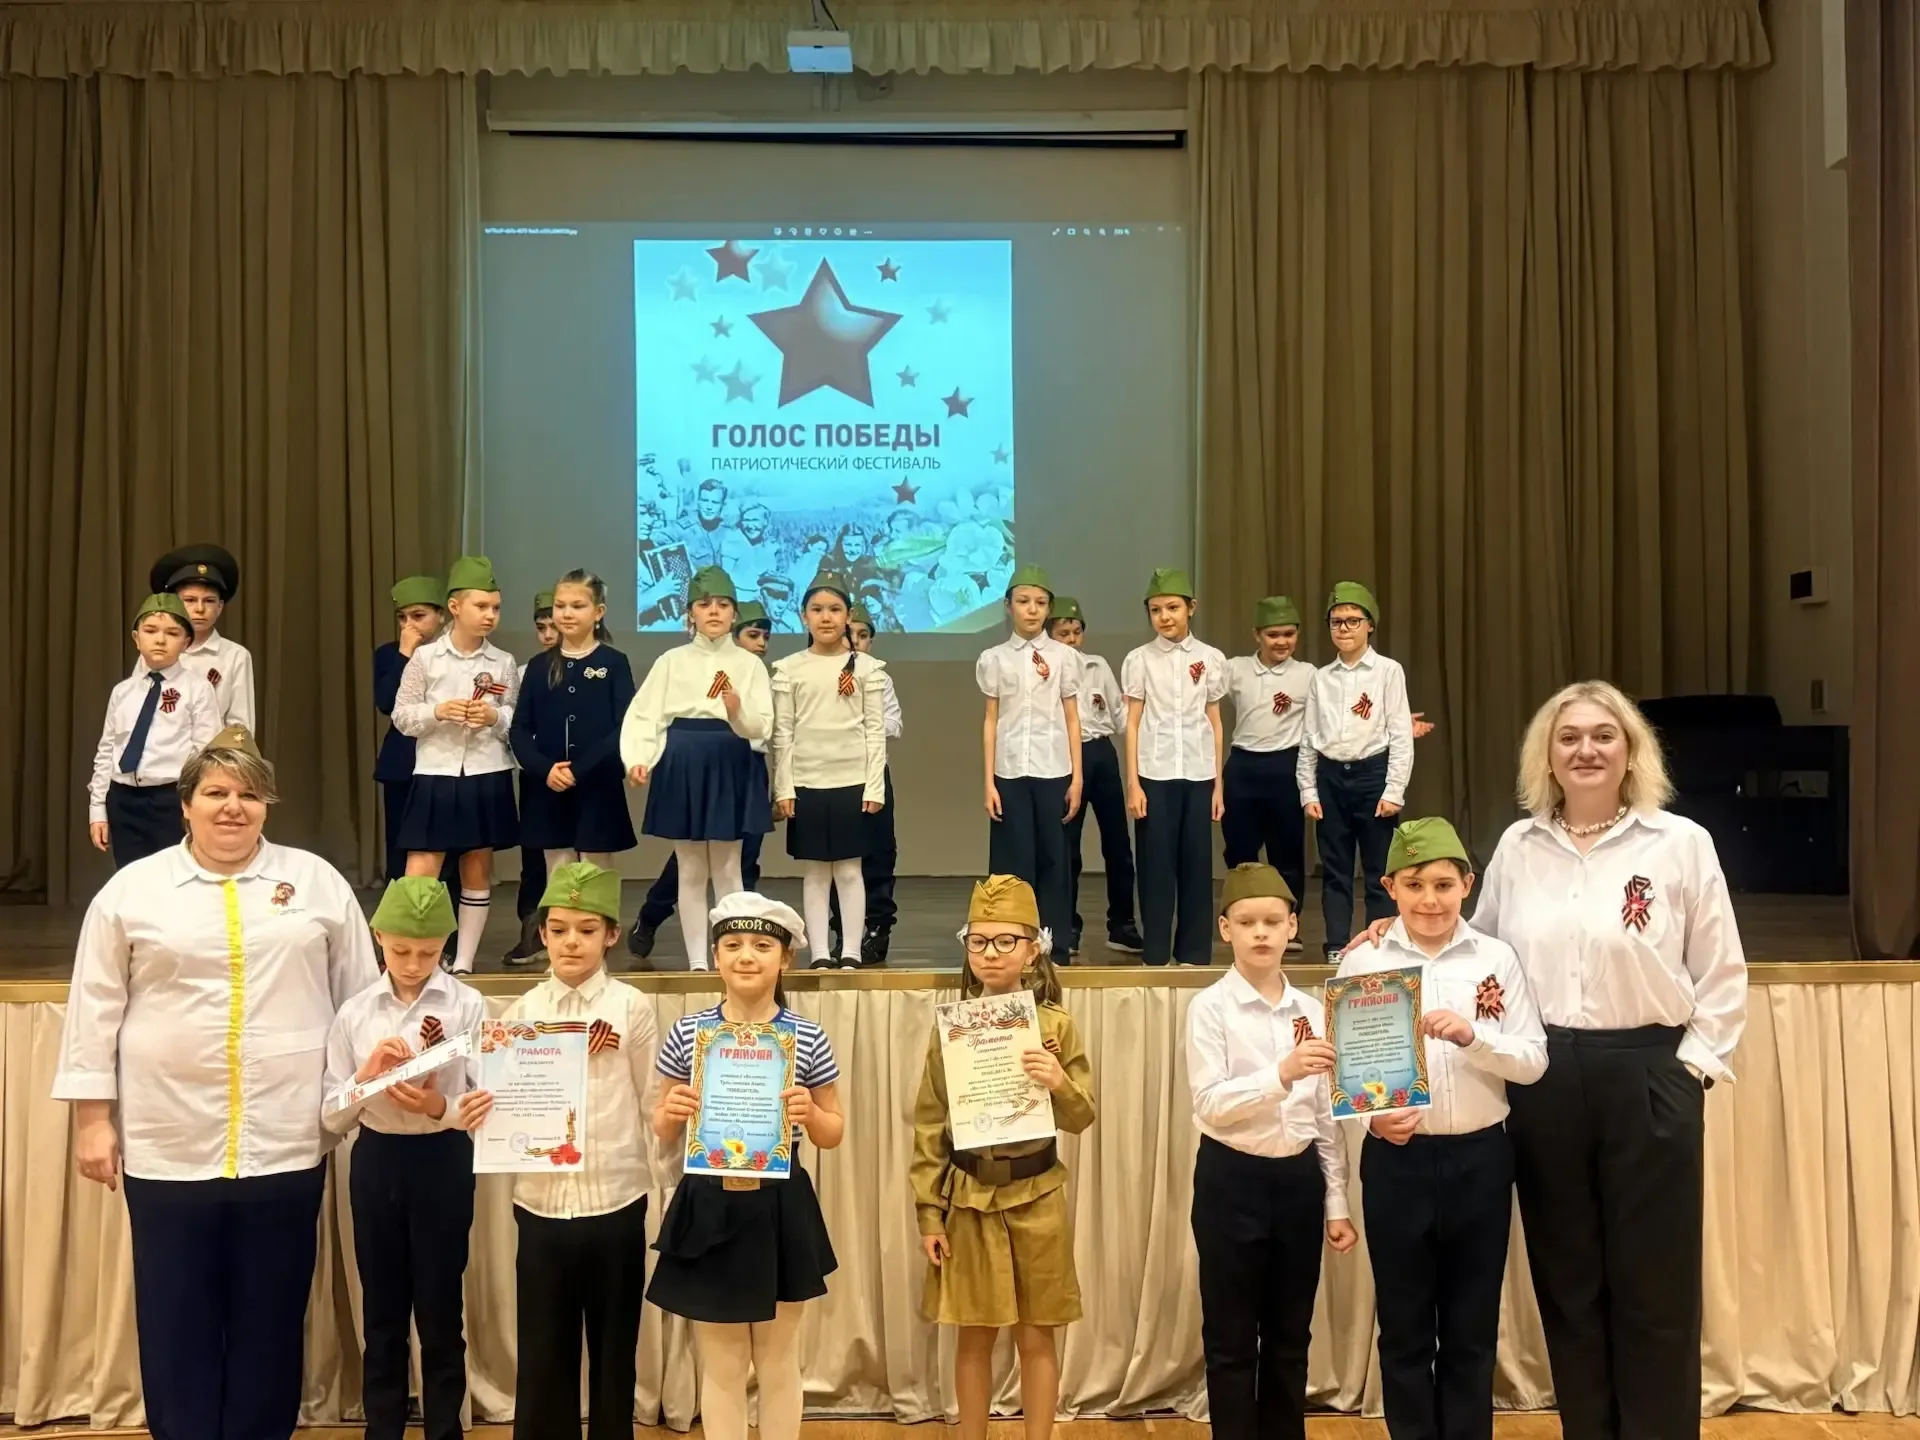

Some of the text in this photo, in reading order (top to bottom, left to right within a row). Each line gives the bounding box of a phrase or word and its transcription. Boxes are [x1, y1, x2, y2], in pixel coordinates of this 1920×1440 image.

[712, 424, 940, 451] ГОЛОС ПОБЕДЫ
[711, 455, 941, 471] ПАТРИОТИЧЕСКИЙ ФЕСТИВАЛЬ
[515, 1047, 562, 1056] ГРАМОТА
